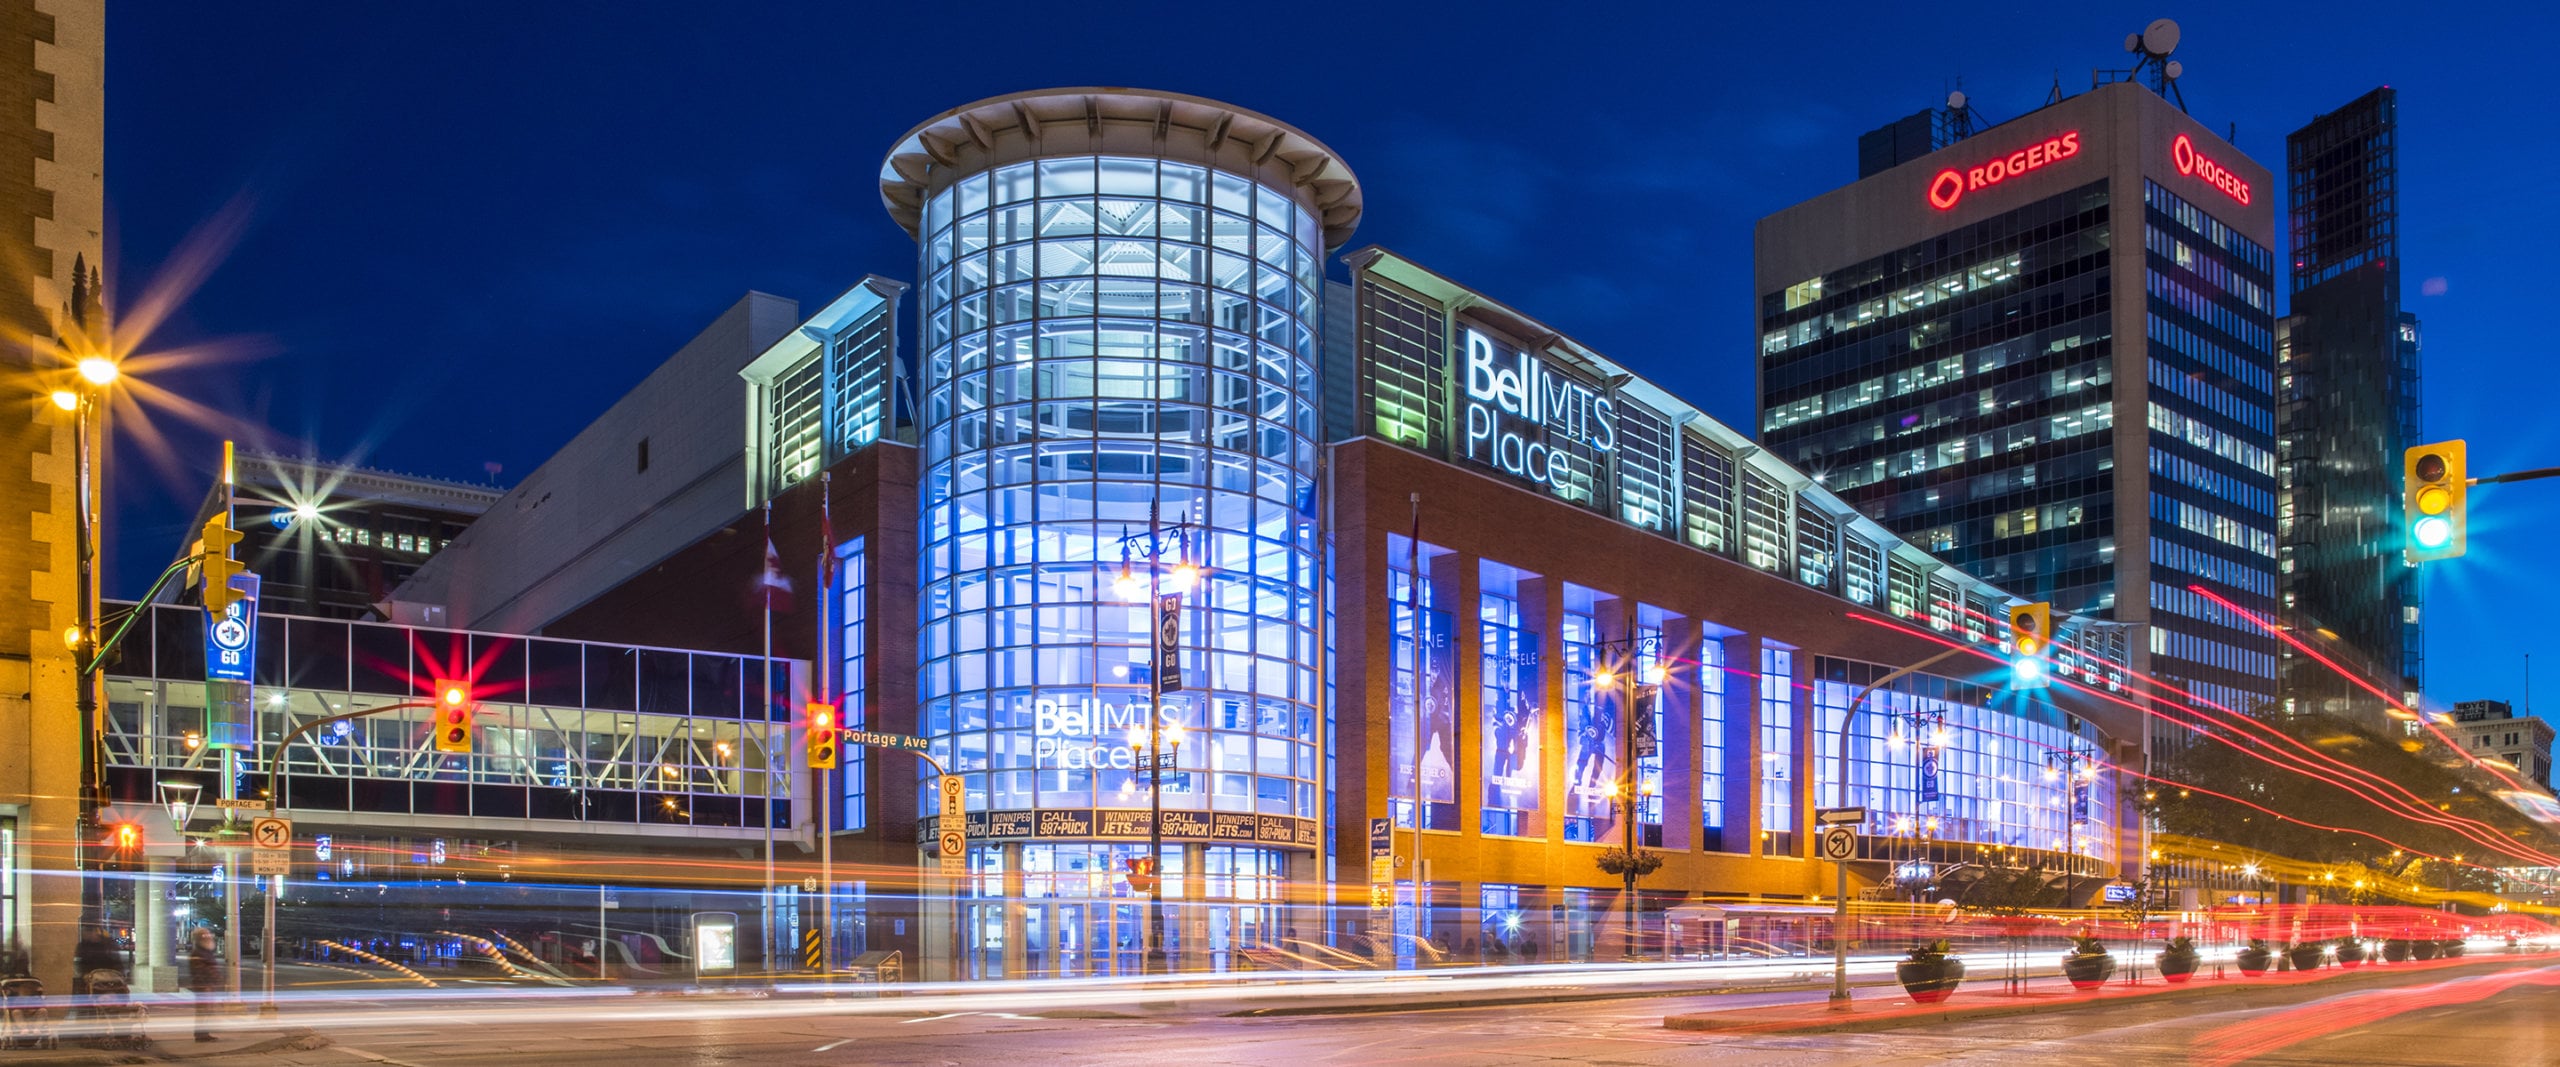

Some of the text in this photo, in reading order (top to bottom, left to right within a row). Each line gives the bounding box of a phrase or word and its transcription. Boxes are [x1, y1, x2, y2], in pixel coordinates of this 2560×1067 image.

[1968, 132, 2079, 191] ROGERS
[2195, 152, 2249, 205] ROGERS
[1467, 402, 1570, 490] Place
[844, 731, 928, 749] Portage Ave
[1036, 737, 1132, 770] Place
[221, 800, 251, 809] PORTAGE
[992, 813, 1031, 824] WINNIPEG
[1041, 812, 1075, 822] CALL
[1105, 811, 1152, 822] WINNIPEG
[1163, 812, 1197, 823] CALL
[1215, 814, 1254, 826] WINNIPEG
[1261, 817, 1283, 828] CALL
[989, 822, 1030, 836] JETS.COM
[1101, 822, 1150, 835] JETS.COM
[1212, 824, 1253, 838] JETS.COM
